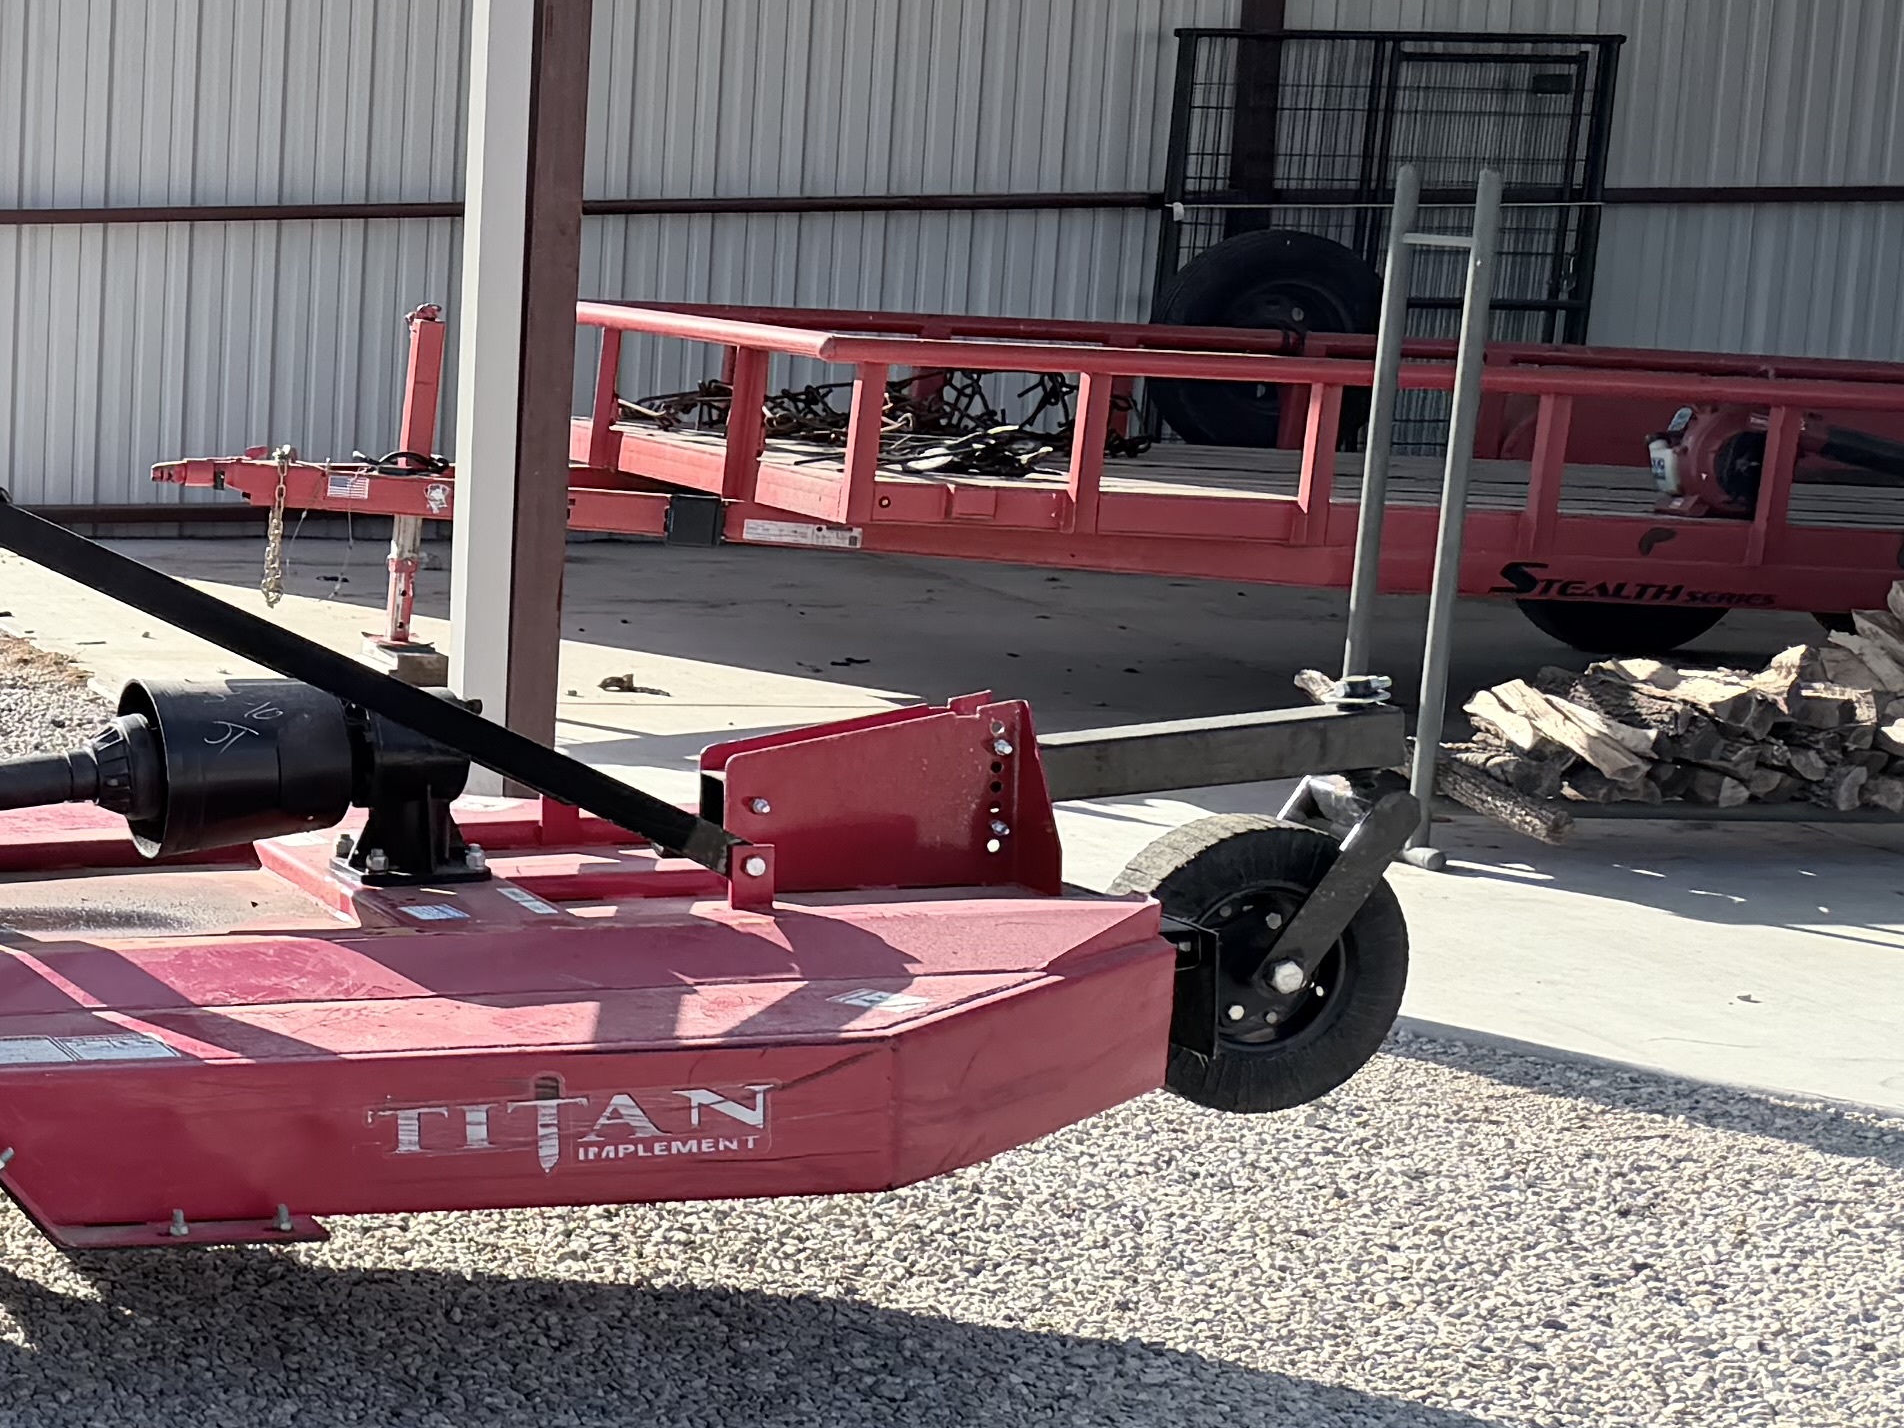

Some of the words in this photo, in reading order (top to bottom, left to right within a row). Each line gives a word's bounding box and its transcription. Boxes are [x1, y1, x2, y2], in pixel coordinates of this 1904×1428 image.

[1487, 561, 1685, 601] STEALTH
[366, 1075, 777, 1174] TITAN
[577, 1135, 760, 1161] IMPLEMENT
